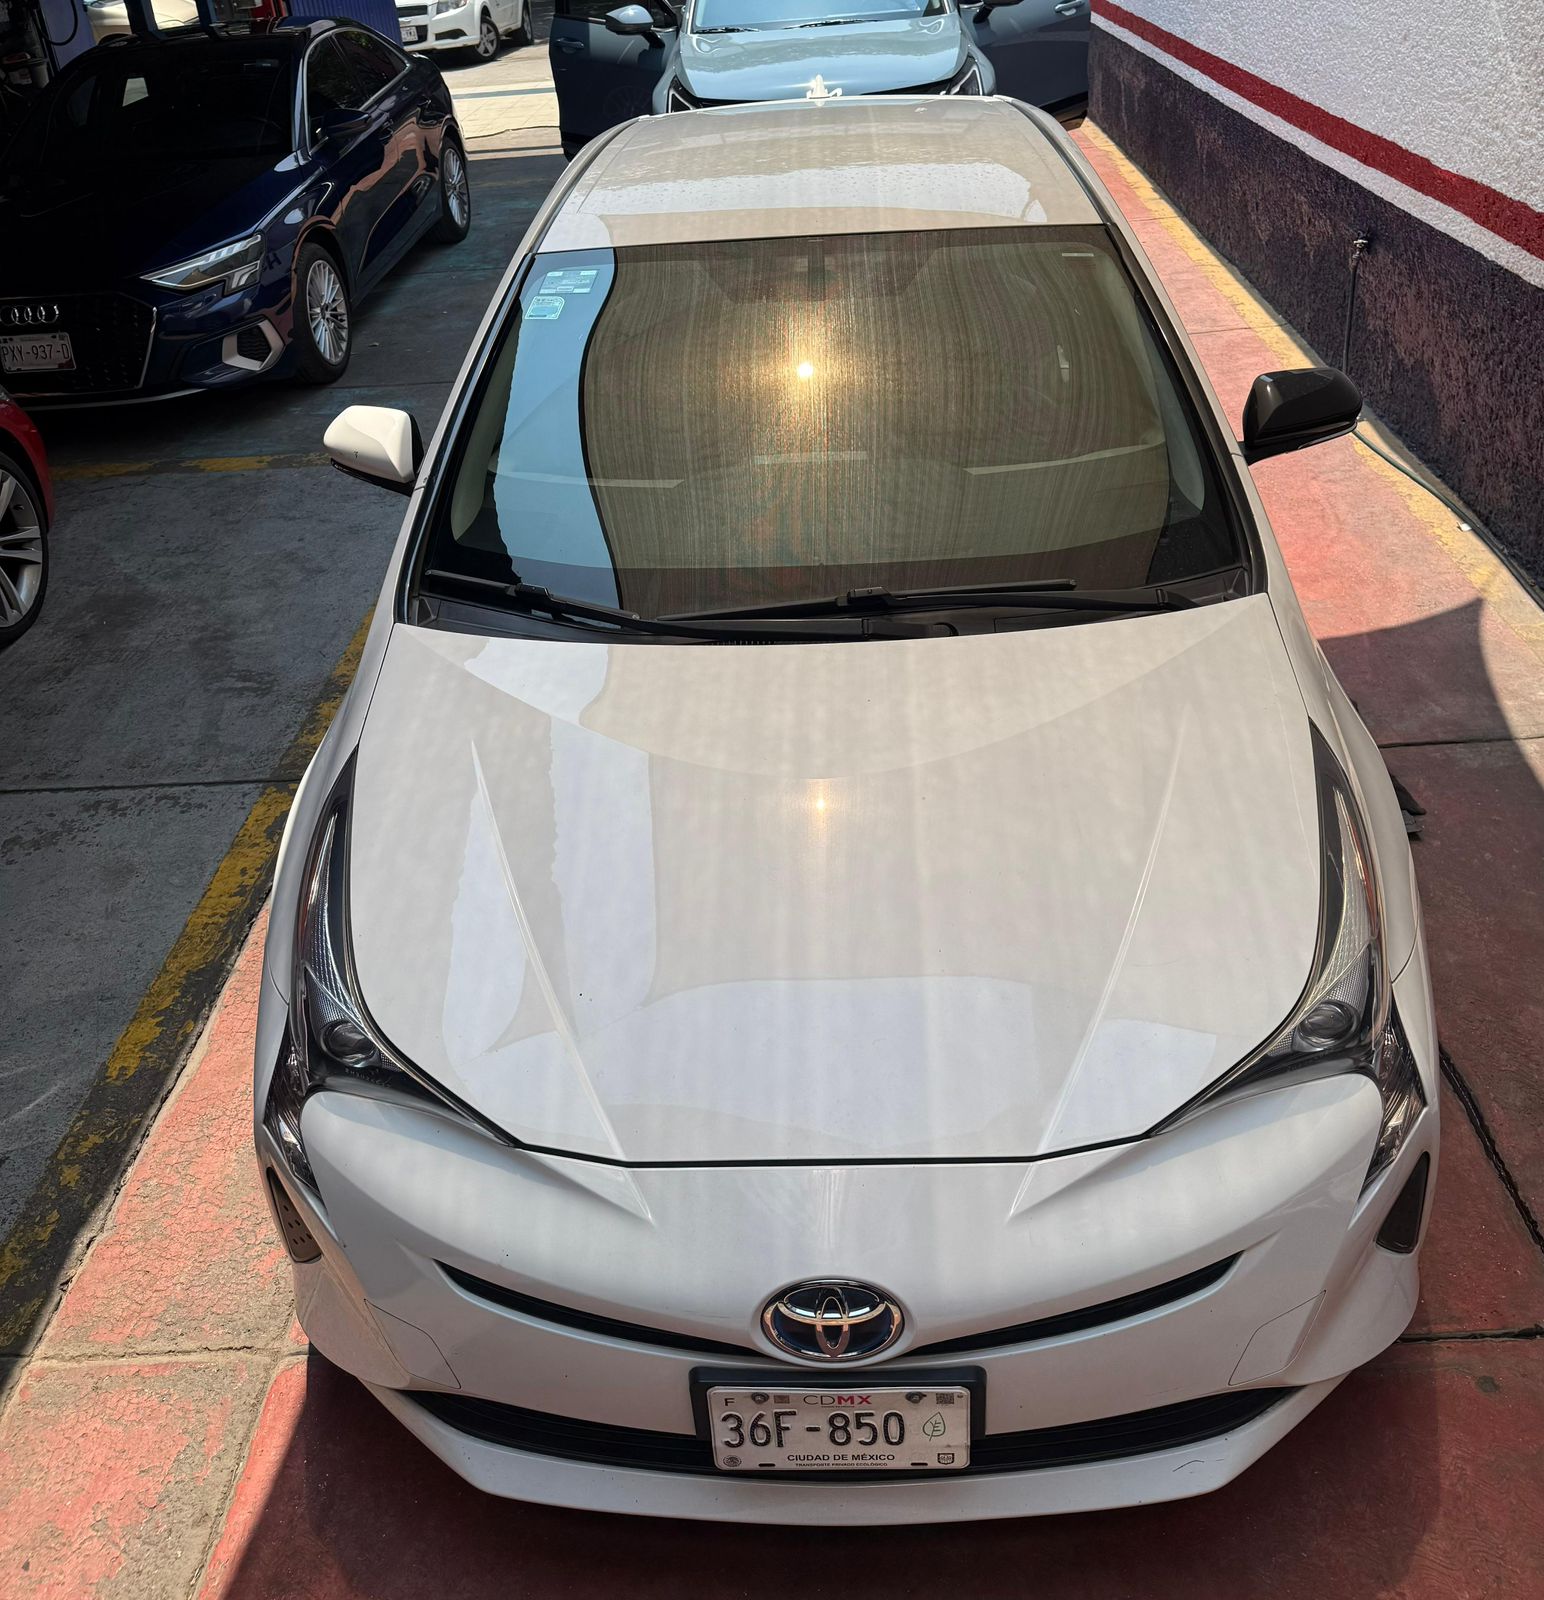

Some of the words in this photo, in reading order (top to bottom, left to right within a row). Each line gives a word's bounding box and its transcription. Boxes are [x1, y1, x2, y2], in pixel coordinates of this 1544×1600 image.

[1, 344, 71, 362] PXY-937-D
[803, 1394, 873, 1406] CDMX
[721, 1409, 906, 1449] 36F-850
[787, 1454, 830, 1462] CIUDAD
[833, 1454, 849, 1462] DE
[851, 1452, 896, 1462] MÉXICO
